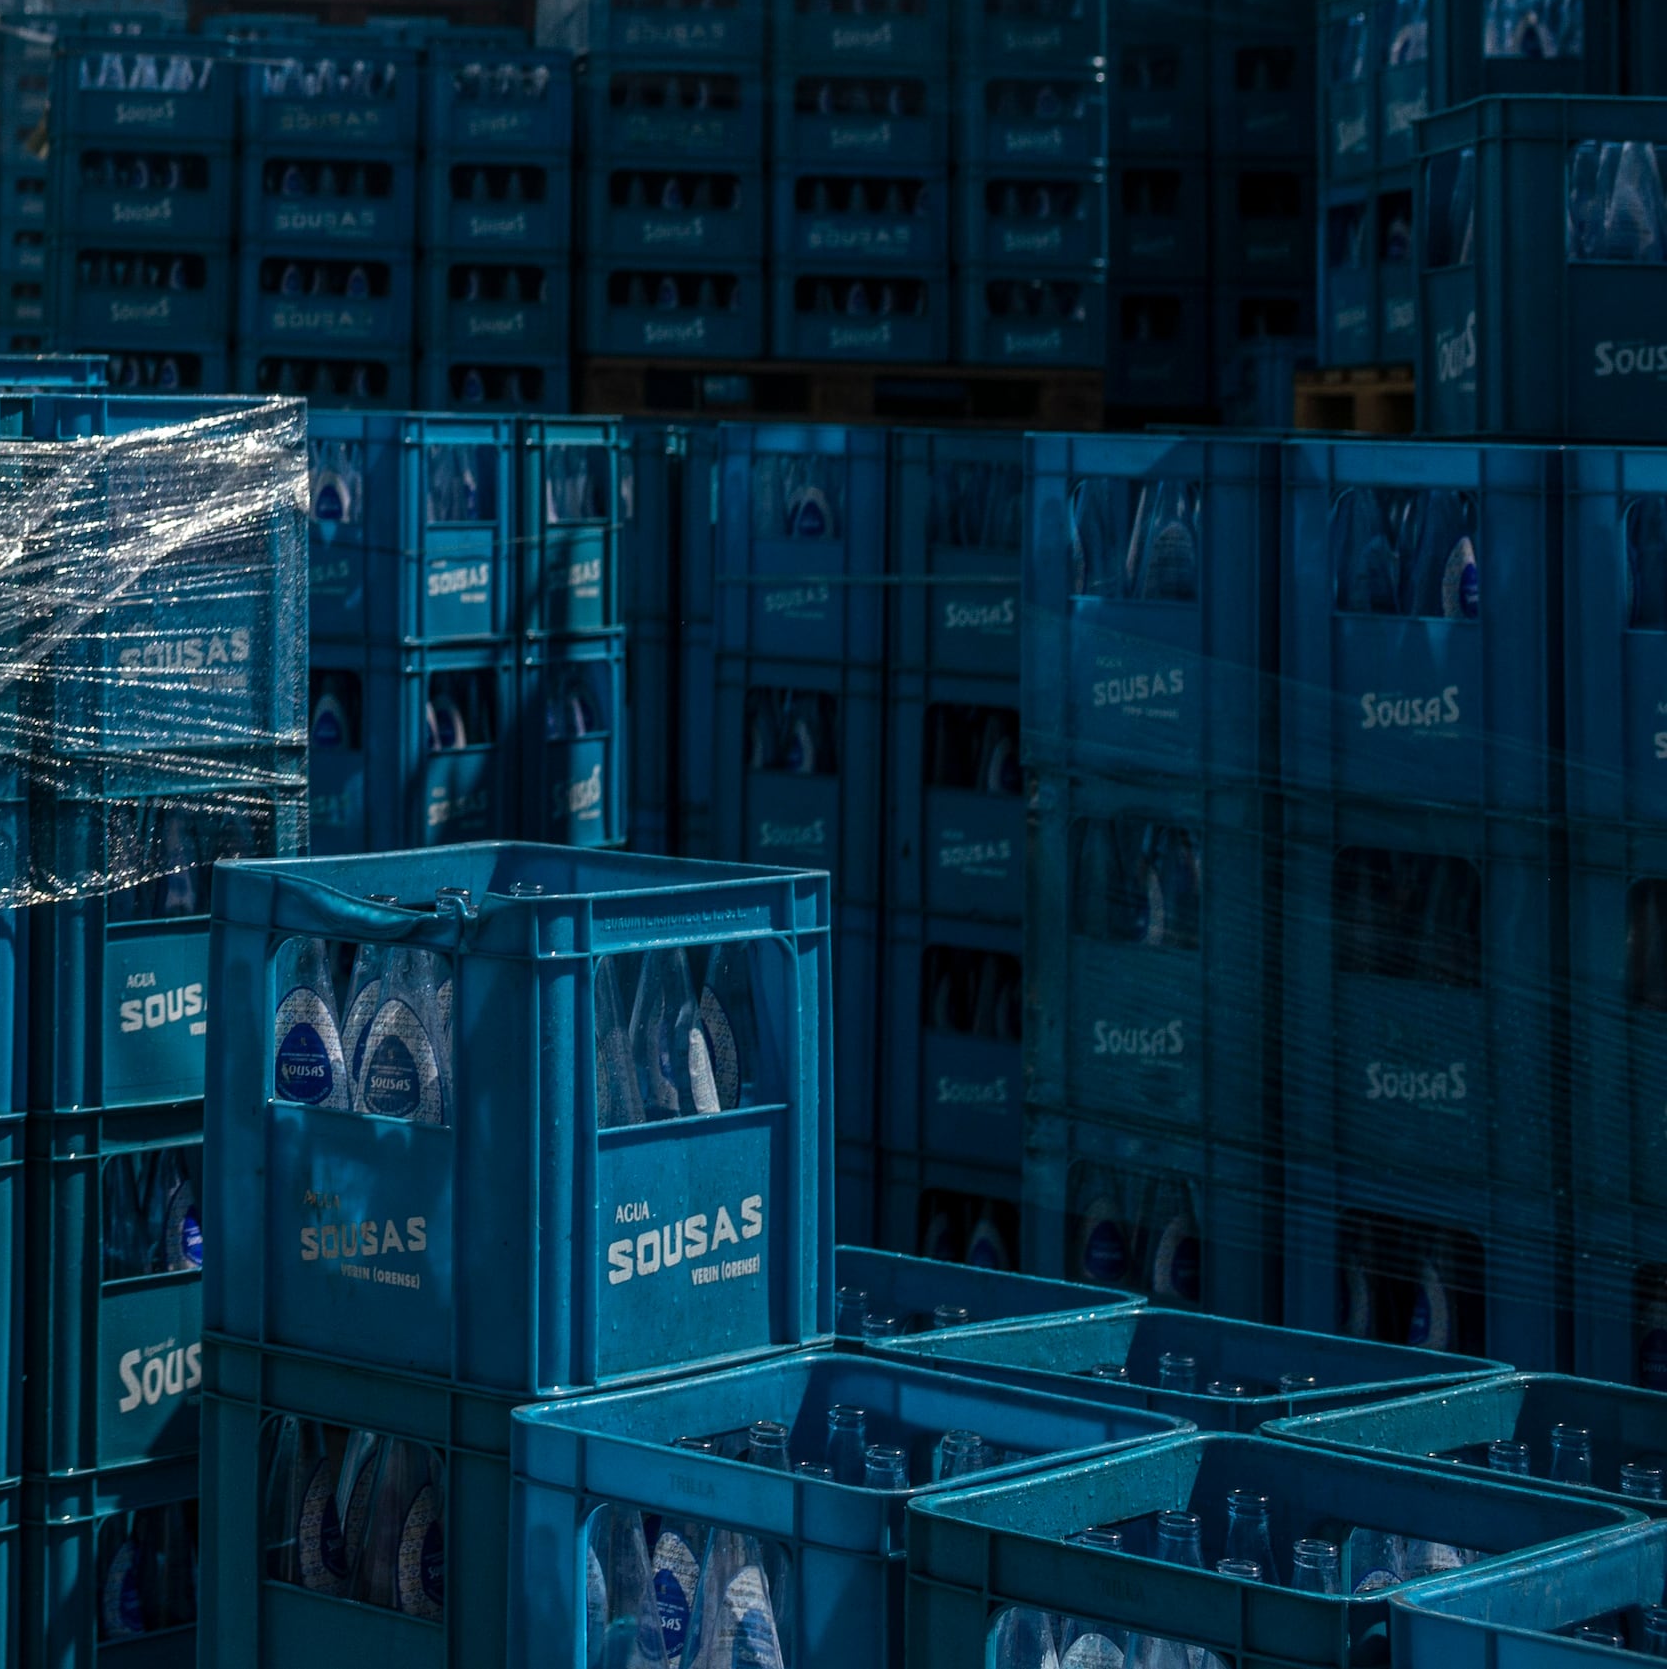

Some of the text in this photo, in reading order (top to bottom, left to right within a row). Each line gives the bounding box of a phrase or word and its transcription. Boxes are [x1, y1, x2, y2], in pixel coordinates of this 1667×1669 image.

[314, 560, 350, 582] SAS
[1093, 668, 1184, 708] SOUSAS
[126, 971, 157, 989] AGUA
[119, 982, 208, 1033] SOUS
[615, 1200, 651, 1224] AGUA
[300, 1216, 427, 1261] SOUSAS
[607, 1194, 763, 1285] SOUSAS
[691, 1253, 761, 1286] VERIN (ORENSE)
